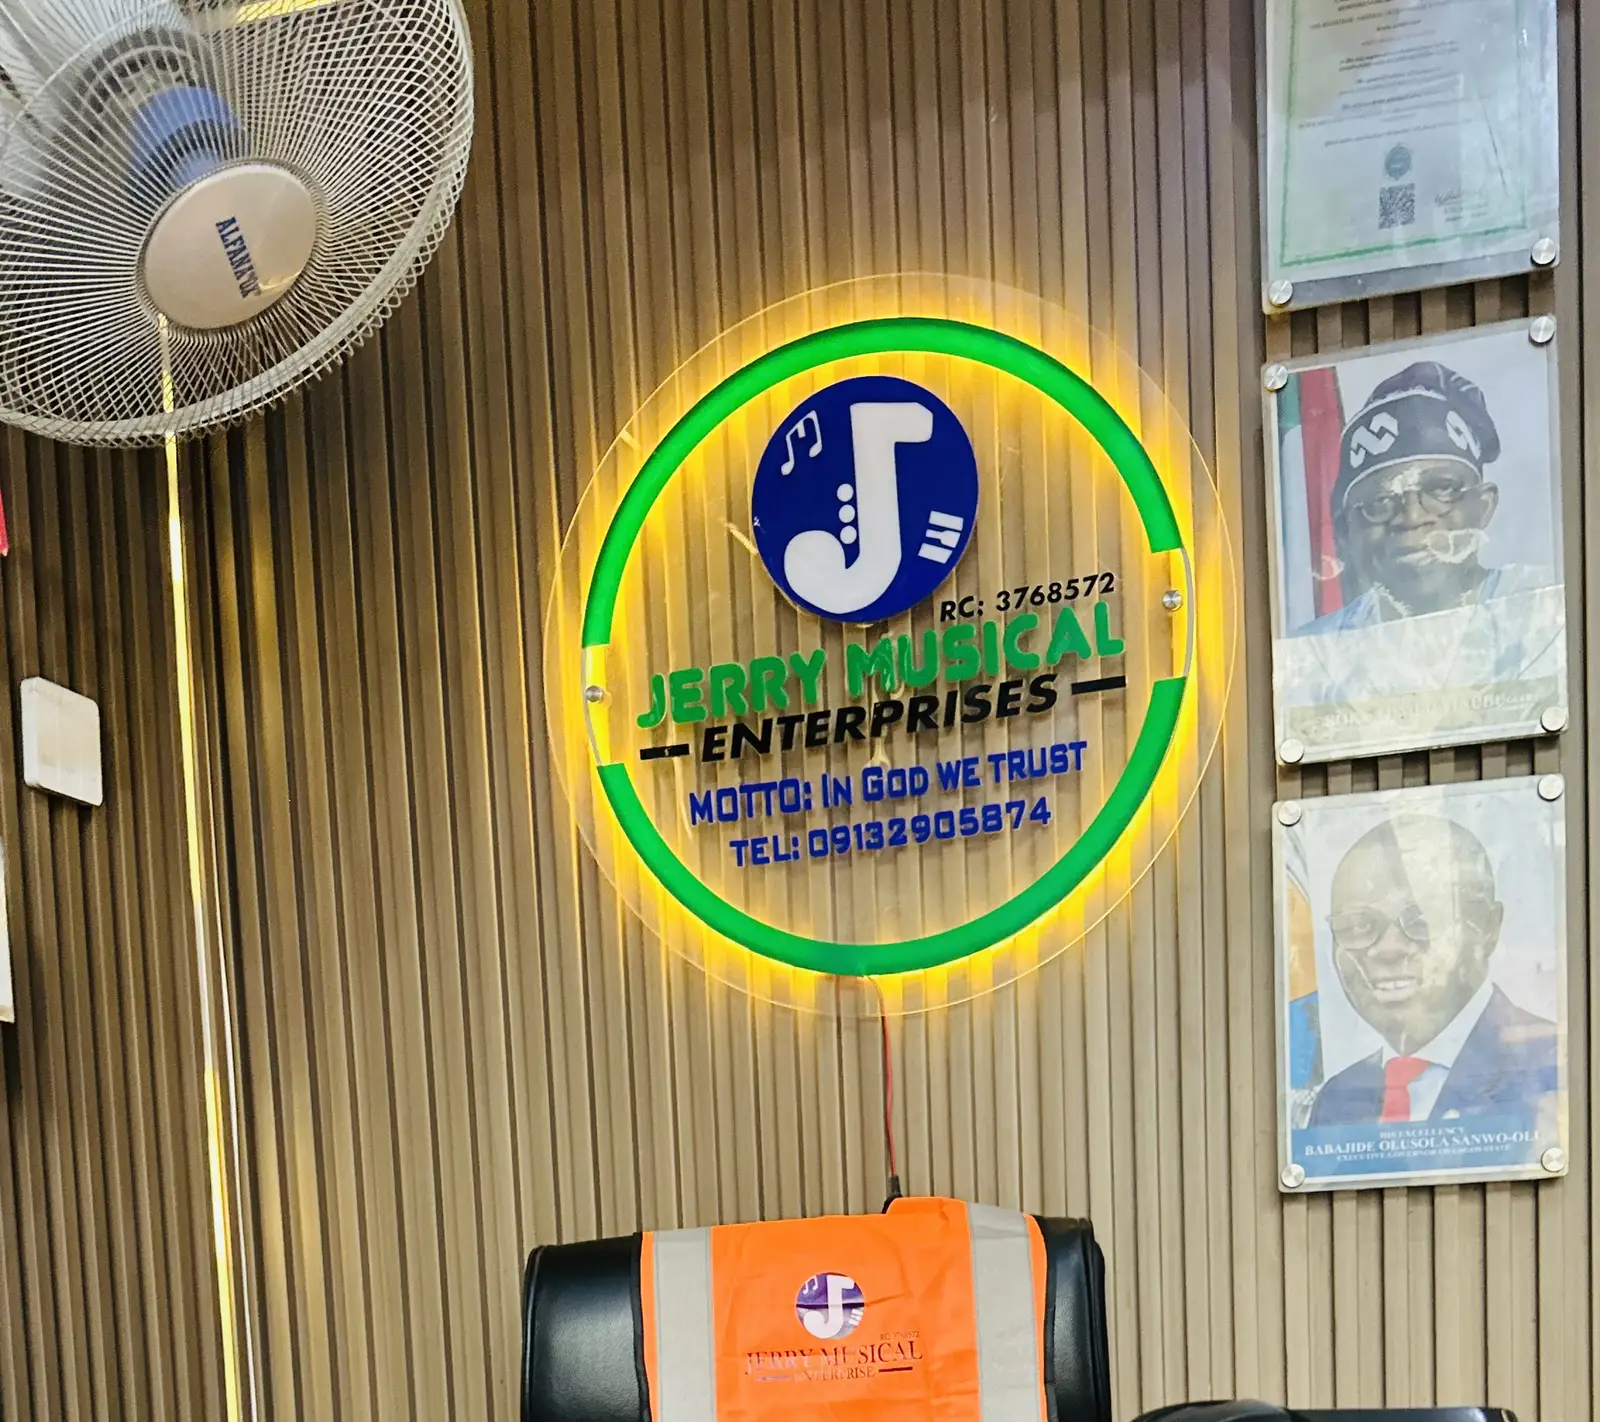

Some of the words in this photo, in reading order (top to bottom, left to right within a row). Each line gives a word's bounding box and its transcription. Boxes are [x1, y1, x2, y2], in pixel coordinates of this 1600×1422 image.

[940, 595, 984, 622] RC:
[996, 572, 1115, 611] 3768572
[637, 649, 826, 729] JERRY
[846, 600, 1125, 697] MUSICAL
[702, 673, 1059, 763] ENTERPRISES
[689, 778, 813, 826] MOTTO:
[936, 756, 980, 791] WE
[988, 741, 1087, 784] TRUST
[729, 835, 800, 867] TEL:
[808, 796, 1052, 859] 09132905874
[1305, 1140, 1376, 1157] BABAJIDE
[1378, 1136, 1450, 1151] OLUSOLA
[745, 1349, 813, 1375] JERRY
[821, 1340, 923, 1367] MUSICAL
